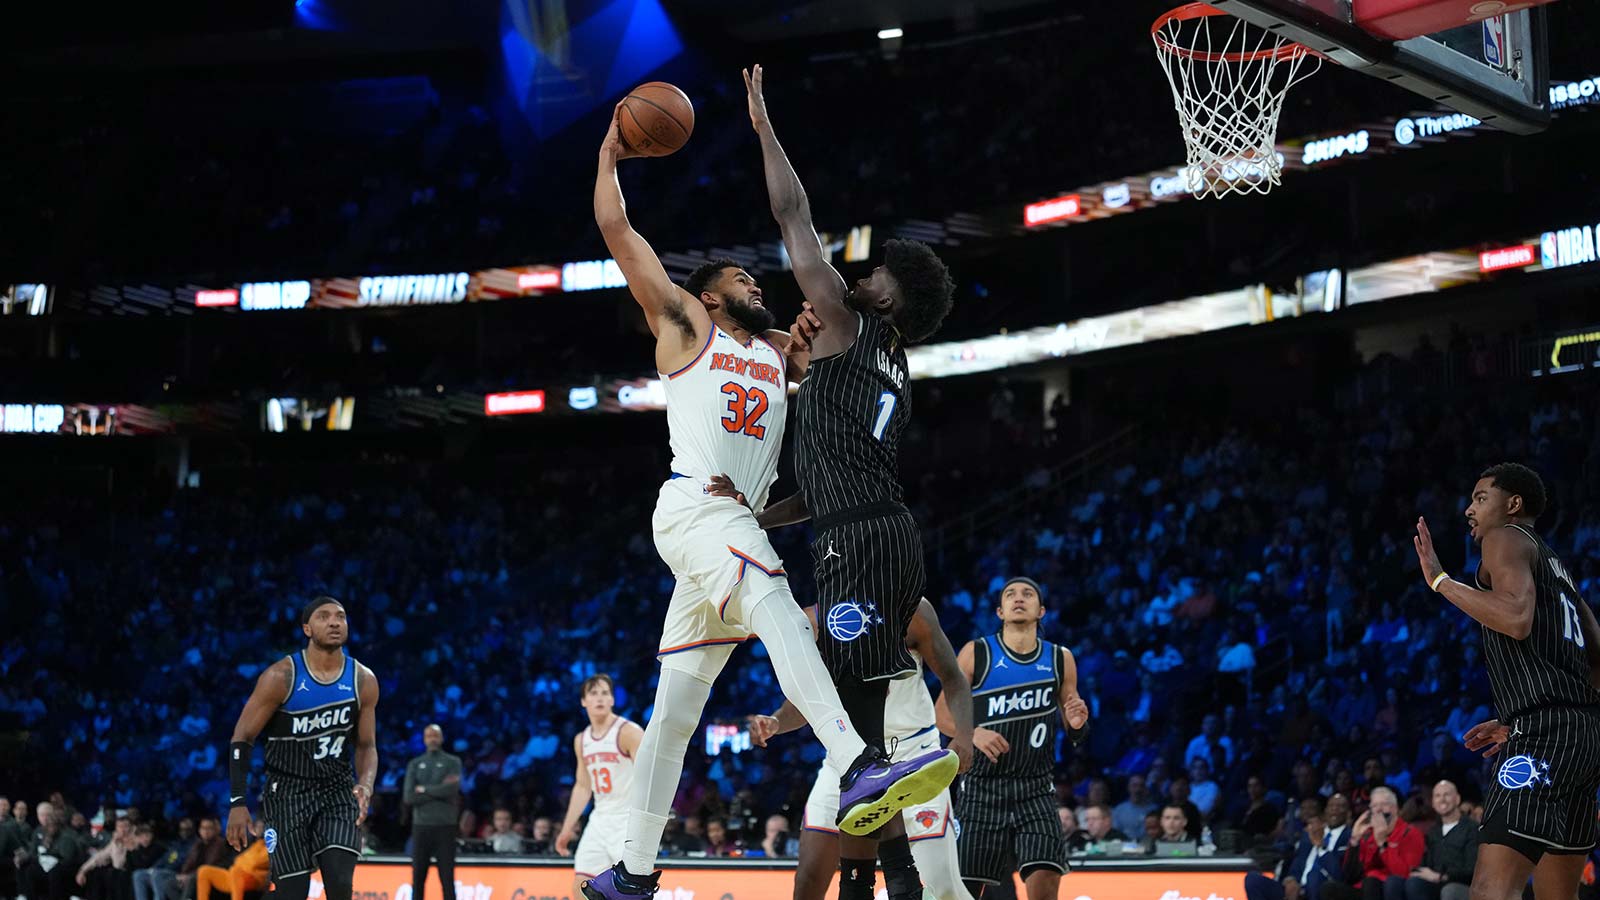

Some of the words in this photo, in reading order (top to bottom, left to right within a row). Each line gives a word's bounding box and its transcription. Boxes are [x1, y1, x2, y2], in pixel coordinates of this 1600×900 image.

[1481, 248, 1531, 269] Emirates
[1557, 225, 1595, 267] NBA
[358, 271, 470, 306] SEMIFINALS
[709, 352, 748, 376] NEW
[746, 358, 781, 389] YORK
[876, 347, 904, 389] ISAAC
[720, 381, 769, 441] 32
[872, 391, 897, 442] 1
[313, 736, 346, 760] 34
[1030, 722, 1047, 748] 0
[592, 767, 612, 794] 13
